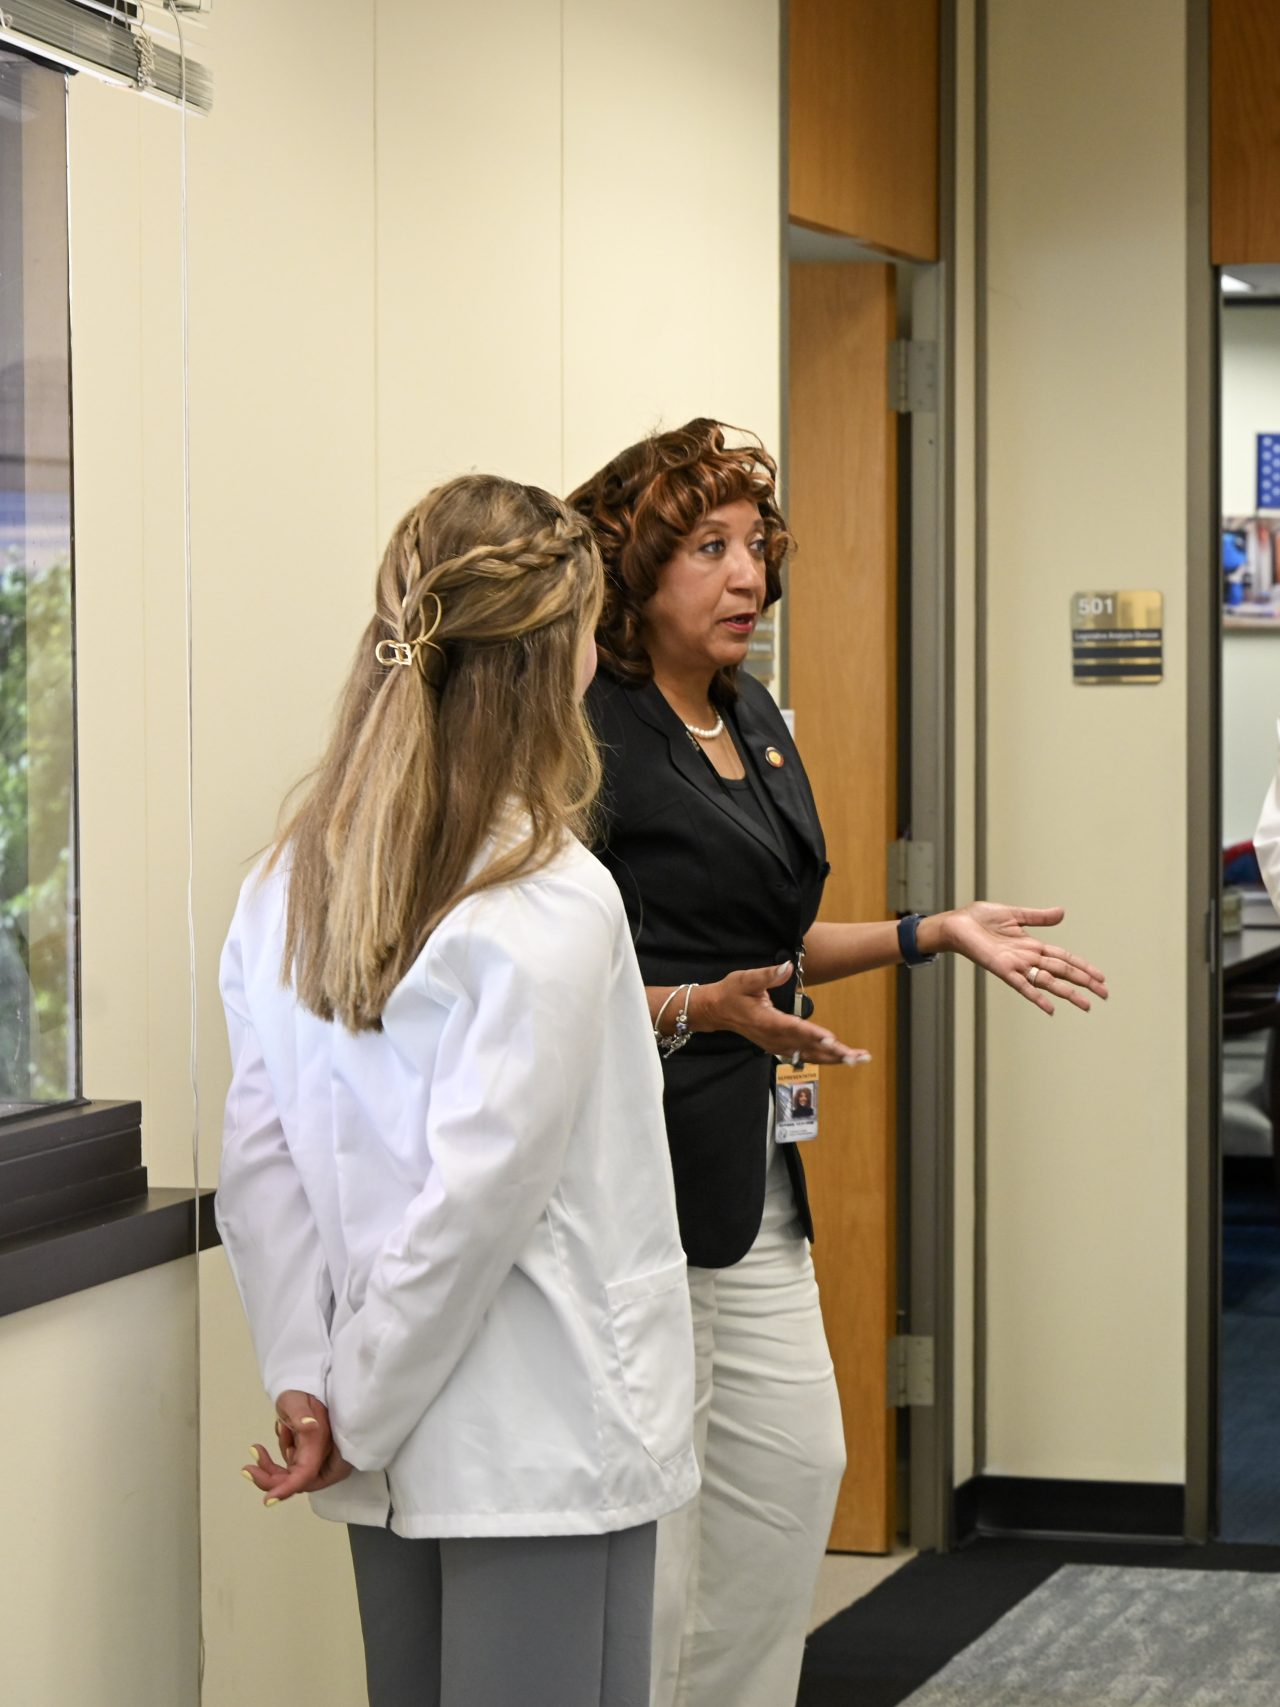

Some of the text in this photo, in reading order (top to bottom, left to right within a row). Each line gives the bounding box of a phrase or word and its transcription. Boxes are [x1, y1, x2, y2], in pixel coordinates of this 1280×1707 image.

[1078, 597, 1113, 615] 501
[1074, 630, 1159, 641] Legislative Analysis Division
